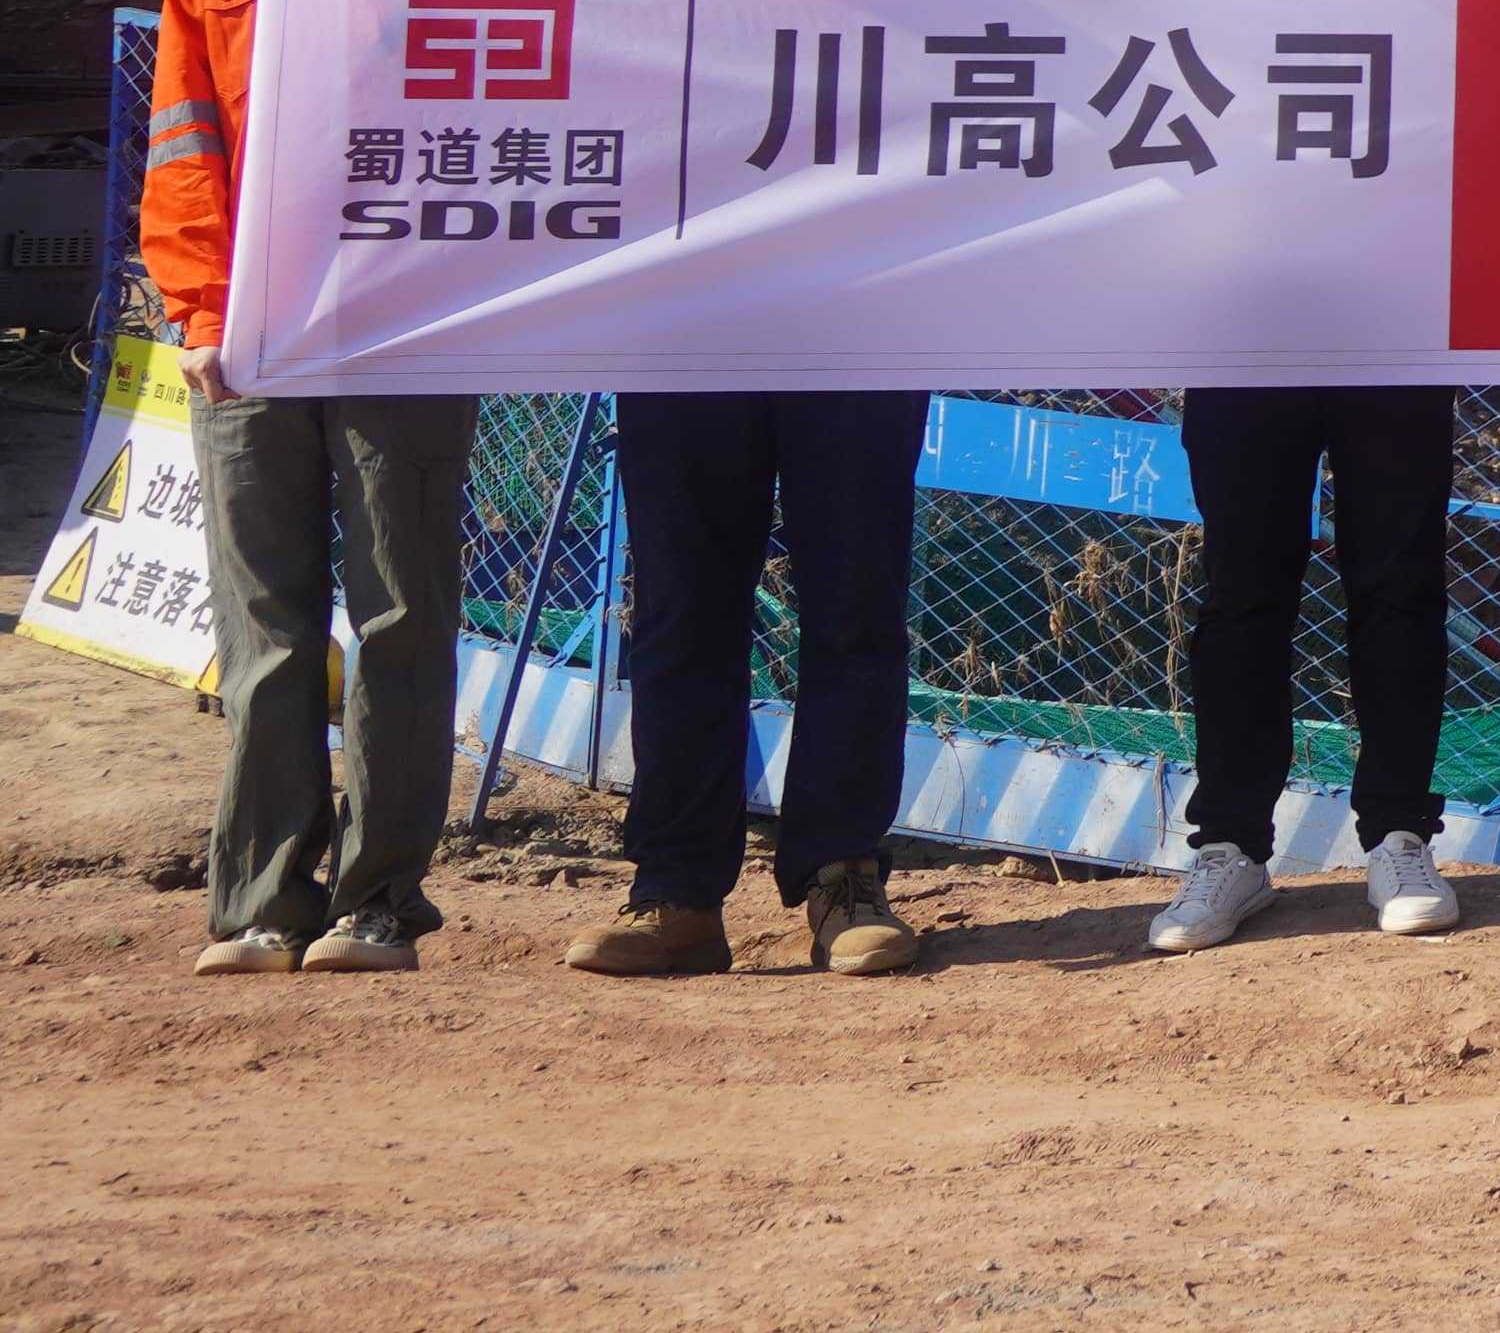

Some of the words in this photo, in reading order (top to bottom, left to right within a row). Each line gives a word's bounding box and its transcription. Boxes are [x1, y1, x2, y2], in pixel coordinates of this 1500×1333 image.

[746, 22, 1394, 179] 川高公司
[345, 127, 624, 186] 蜀道集团
[339, 200, 621, 241] SDIG
[138, 464, 206, 531] 边坡
